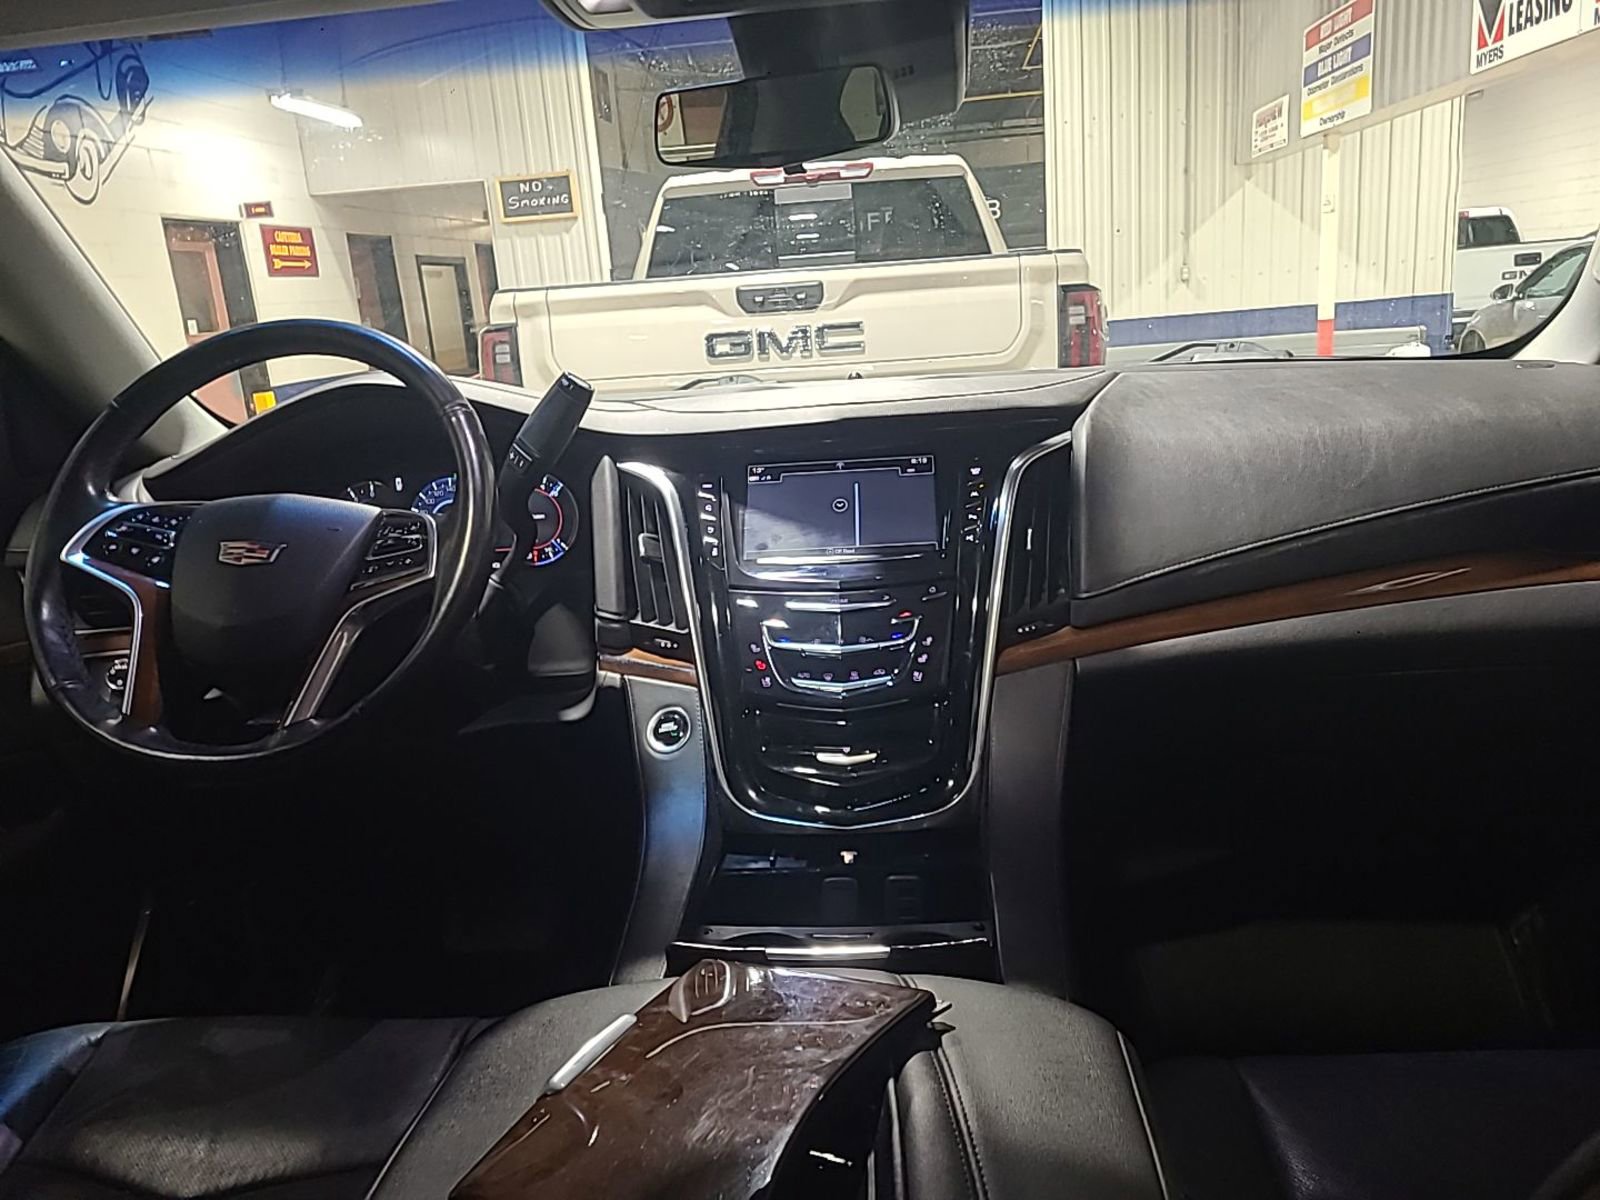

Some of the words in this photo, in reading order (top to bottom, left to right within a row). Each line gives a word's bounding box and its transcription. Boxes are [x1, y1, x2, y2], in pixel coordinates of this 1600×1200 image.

[1476, 45, 1504, 68] MYERS
[1319, 110, 1346, 126] Ownership
[705, 321, 865, 364] GMC
